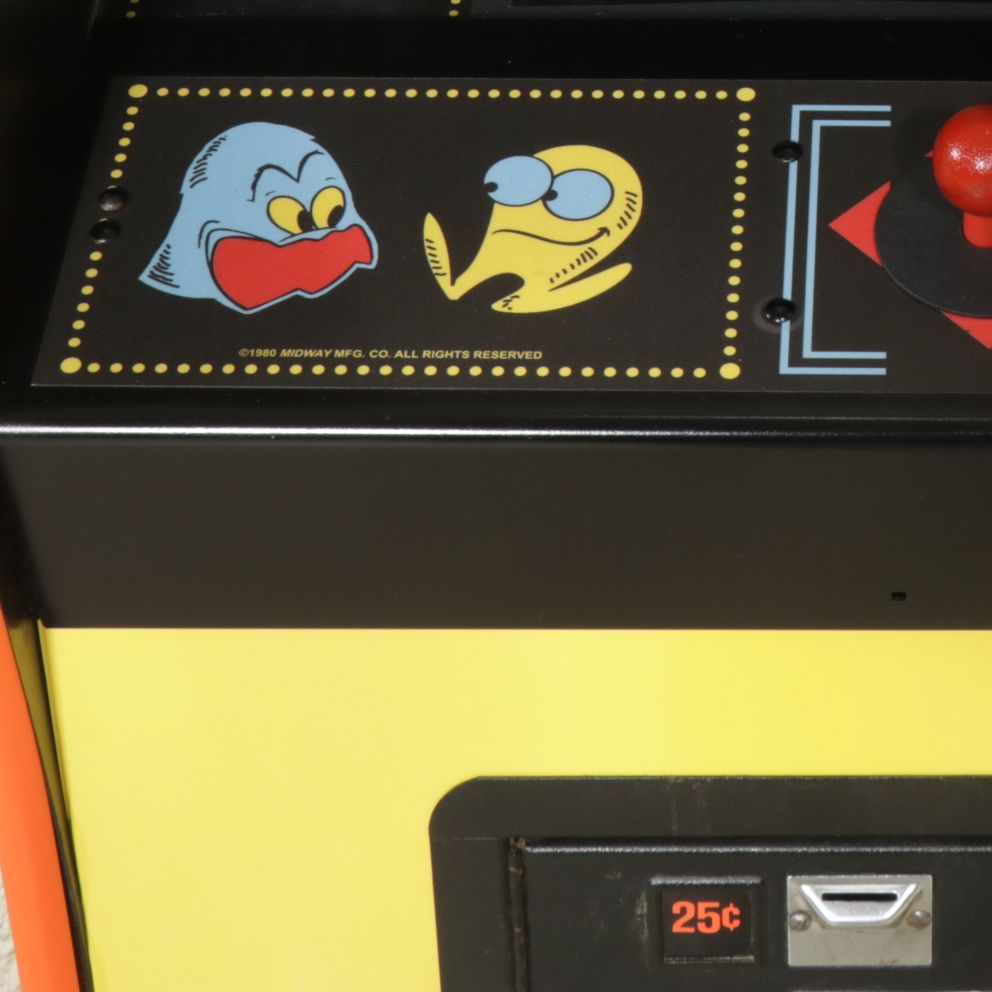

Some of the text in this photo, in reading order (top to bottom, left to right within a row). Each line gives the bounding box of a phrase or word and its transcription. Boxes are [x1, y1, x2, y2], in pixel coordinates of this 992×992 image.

[279, 348, 333, 358] MIDWAY
[334, 349, 365, 358] MFG.
[369, 349, 392, 358] CO.
[394, 349, 419, 358] ALL
[422, 350, 470, 359] RIGHTS
[473, 350, 543, 360] RESERVED
[672, 901, 741, 934] 25¢
